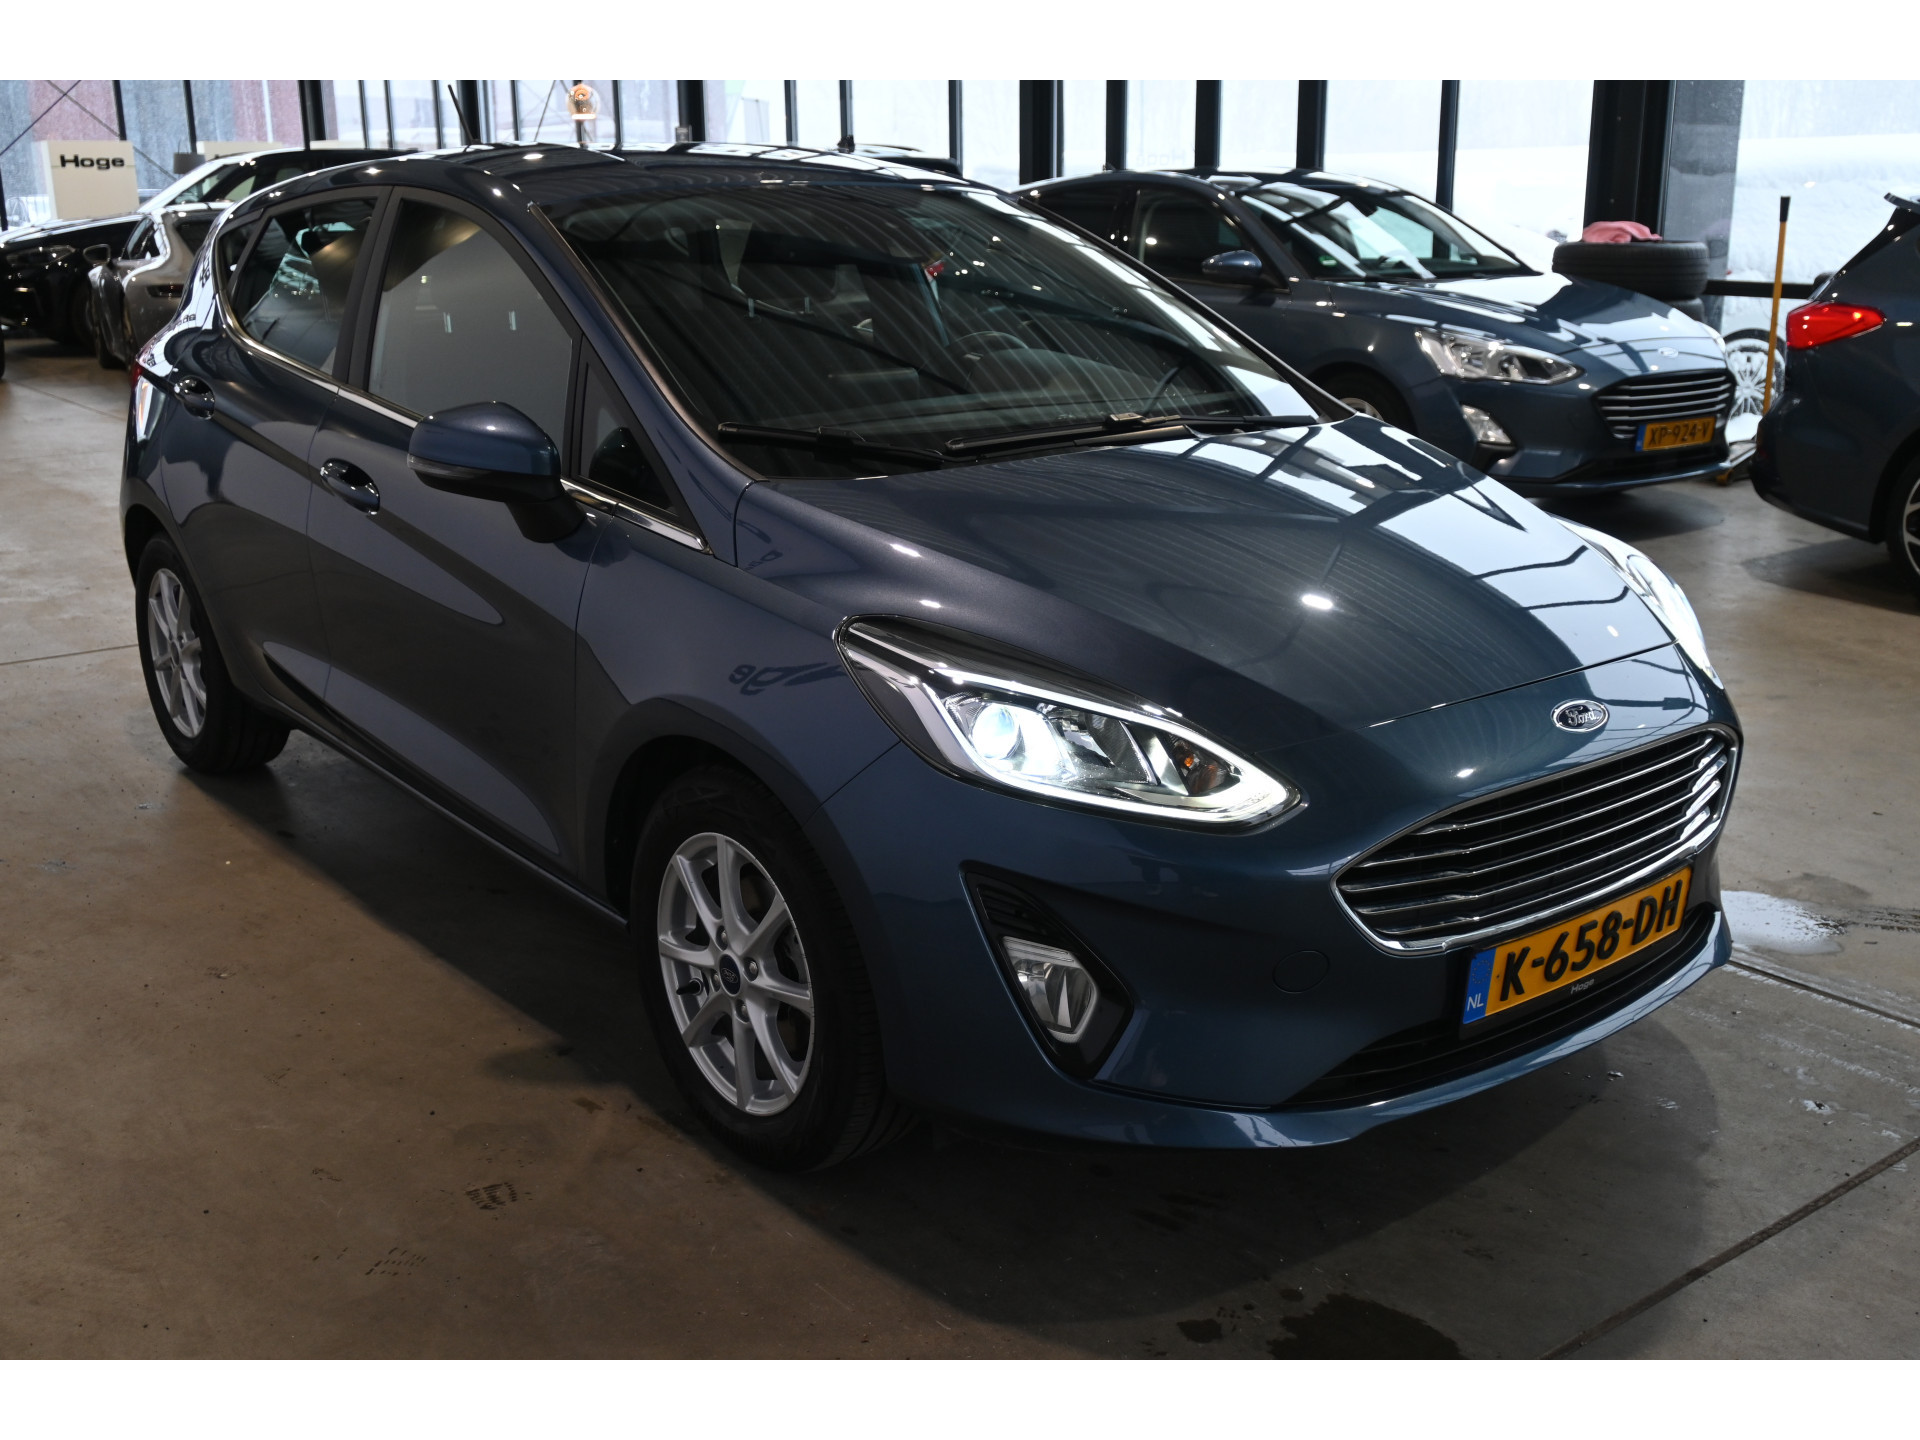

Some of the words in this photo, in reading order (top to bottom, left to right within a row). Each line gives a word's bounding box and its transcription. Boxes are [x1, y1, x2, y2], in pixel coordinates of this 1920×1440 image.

[60, 154, 125, 170] Hoge
[1500, 879, 1683, 1001] K-658-DH
[1570, 978, 1595, 995] Hoge
[1466, 992, 1485, 1012] NL
